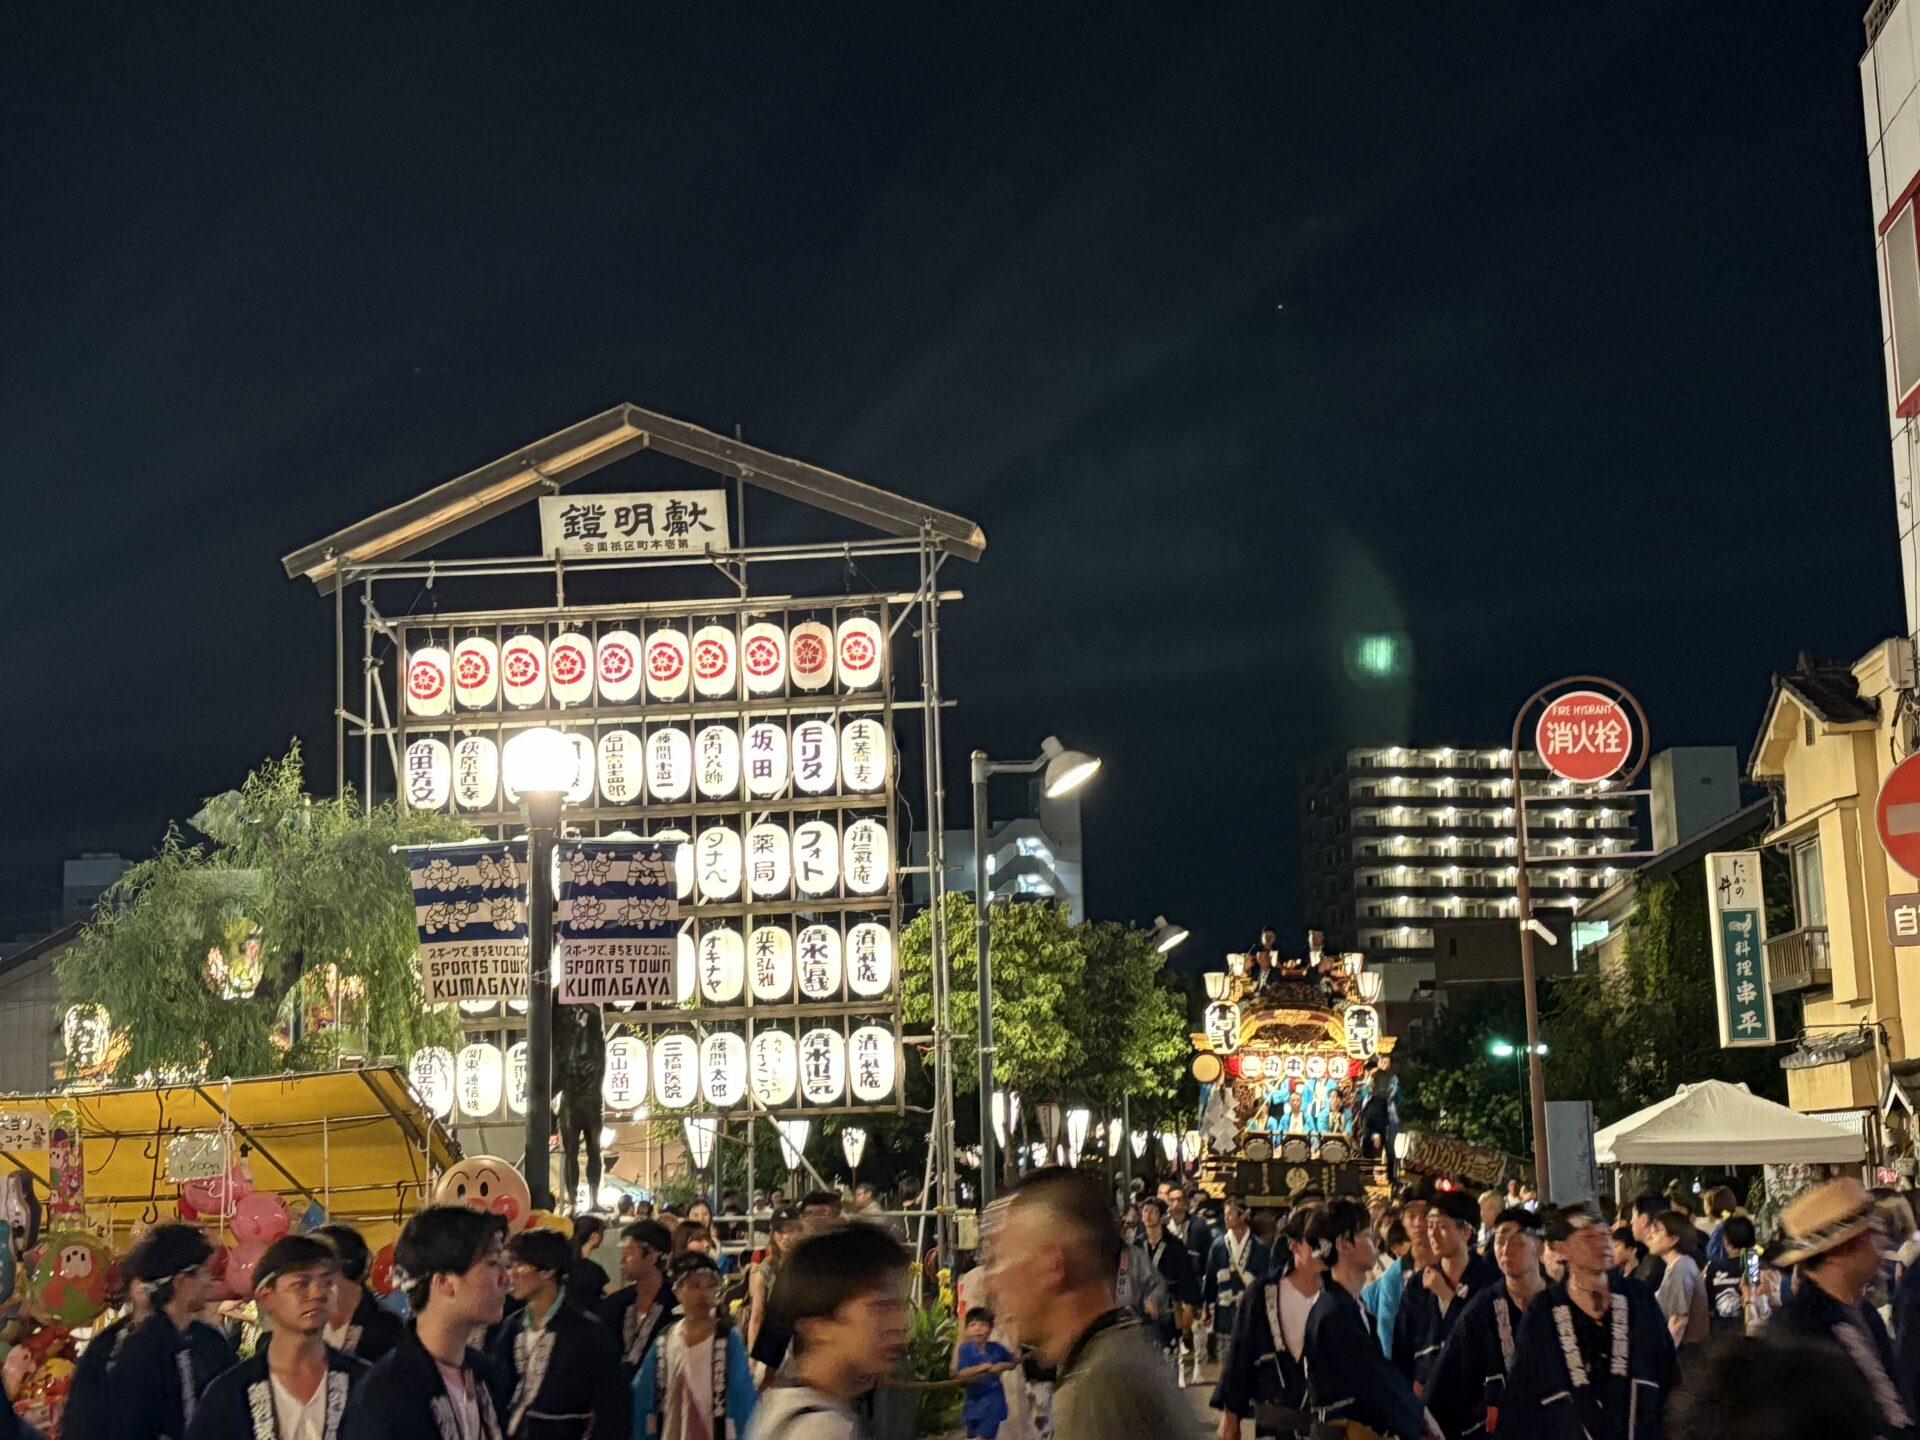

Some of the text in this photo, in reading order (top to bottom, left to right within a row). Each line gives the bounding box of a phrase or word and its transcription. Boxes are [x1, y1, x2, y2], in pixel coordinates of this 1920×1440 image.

[1552, 704, 1612, 716] FIRE HYDRANT
[751, 729, 774, 779] 坂田
[800, 726, 823, 781] モリタ
[851, 722, 873, 784] 生蕎麦
[1546, 718, 1623, 755] 消火栓
[752, 833, 776, 882] 薬局
[800, 829, 825, 881] フォト
[1895, 904, 1920, 937] 自
[431, 959, 488, 977] SPORTS
[565, 959, 671, 975] SPORTS TOWN
[565, 977, 670, 998] KUMAGAYA
[704, 934, 723, 994] オキナヤ
[1733, 939, 1763, 1035] 料理串平
[609, 1042, 631, 1102] 石山商工
